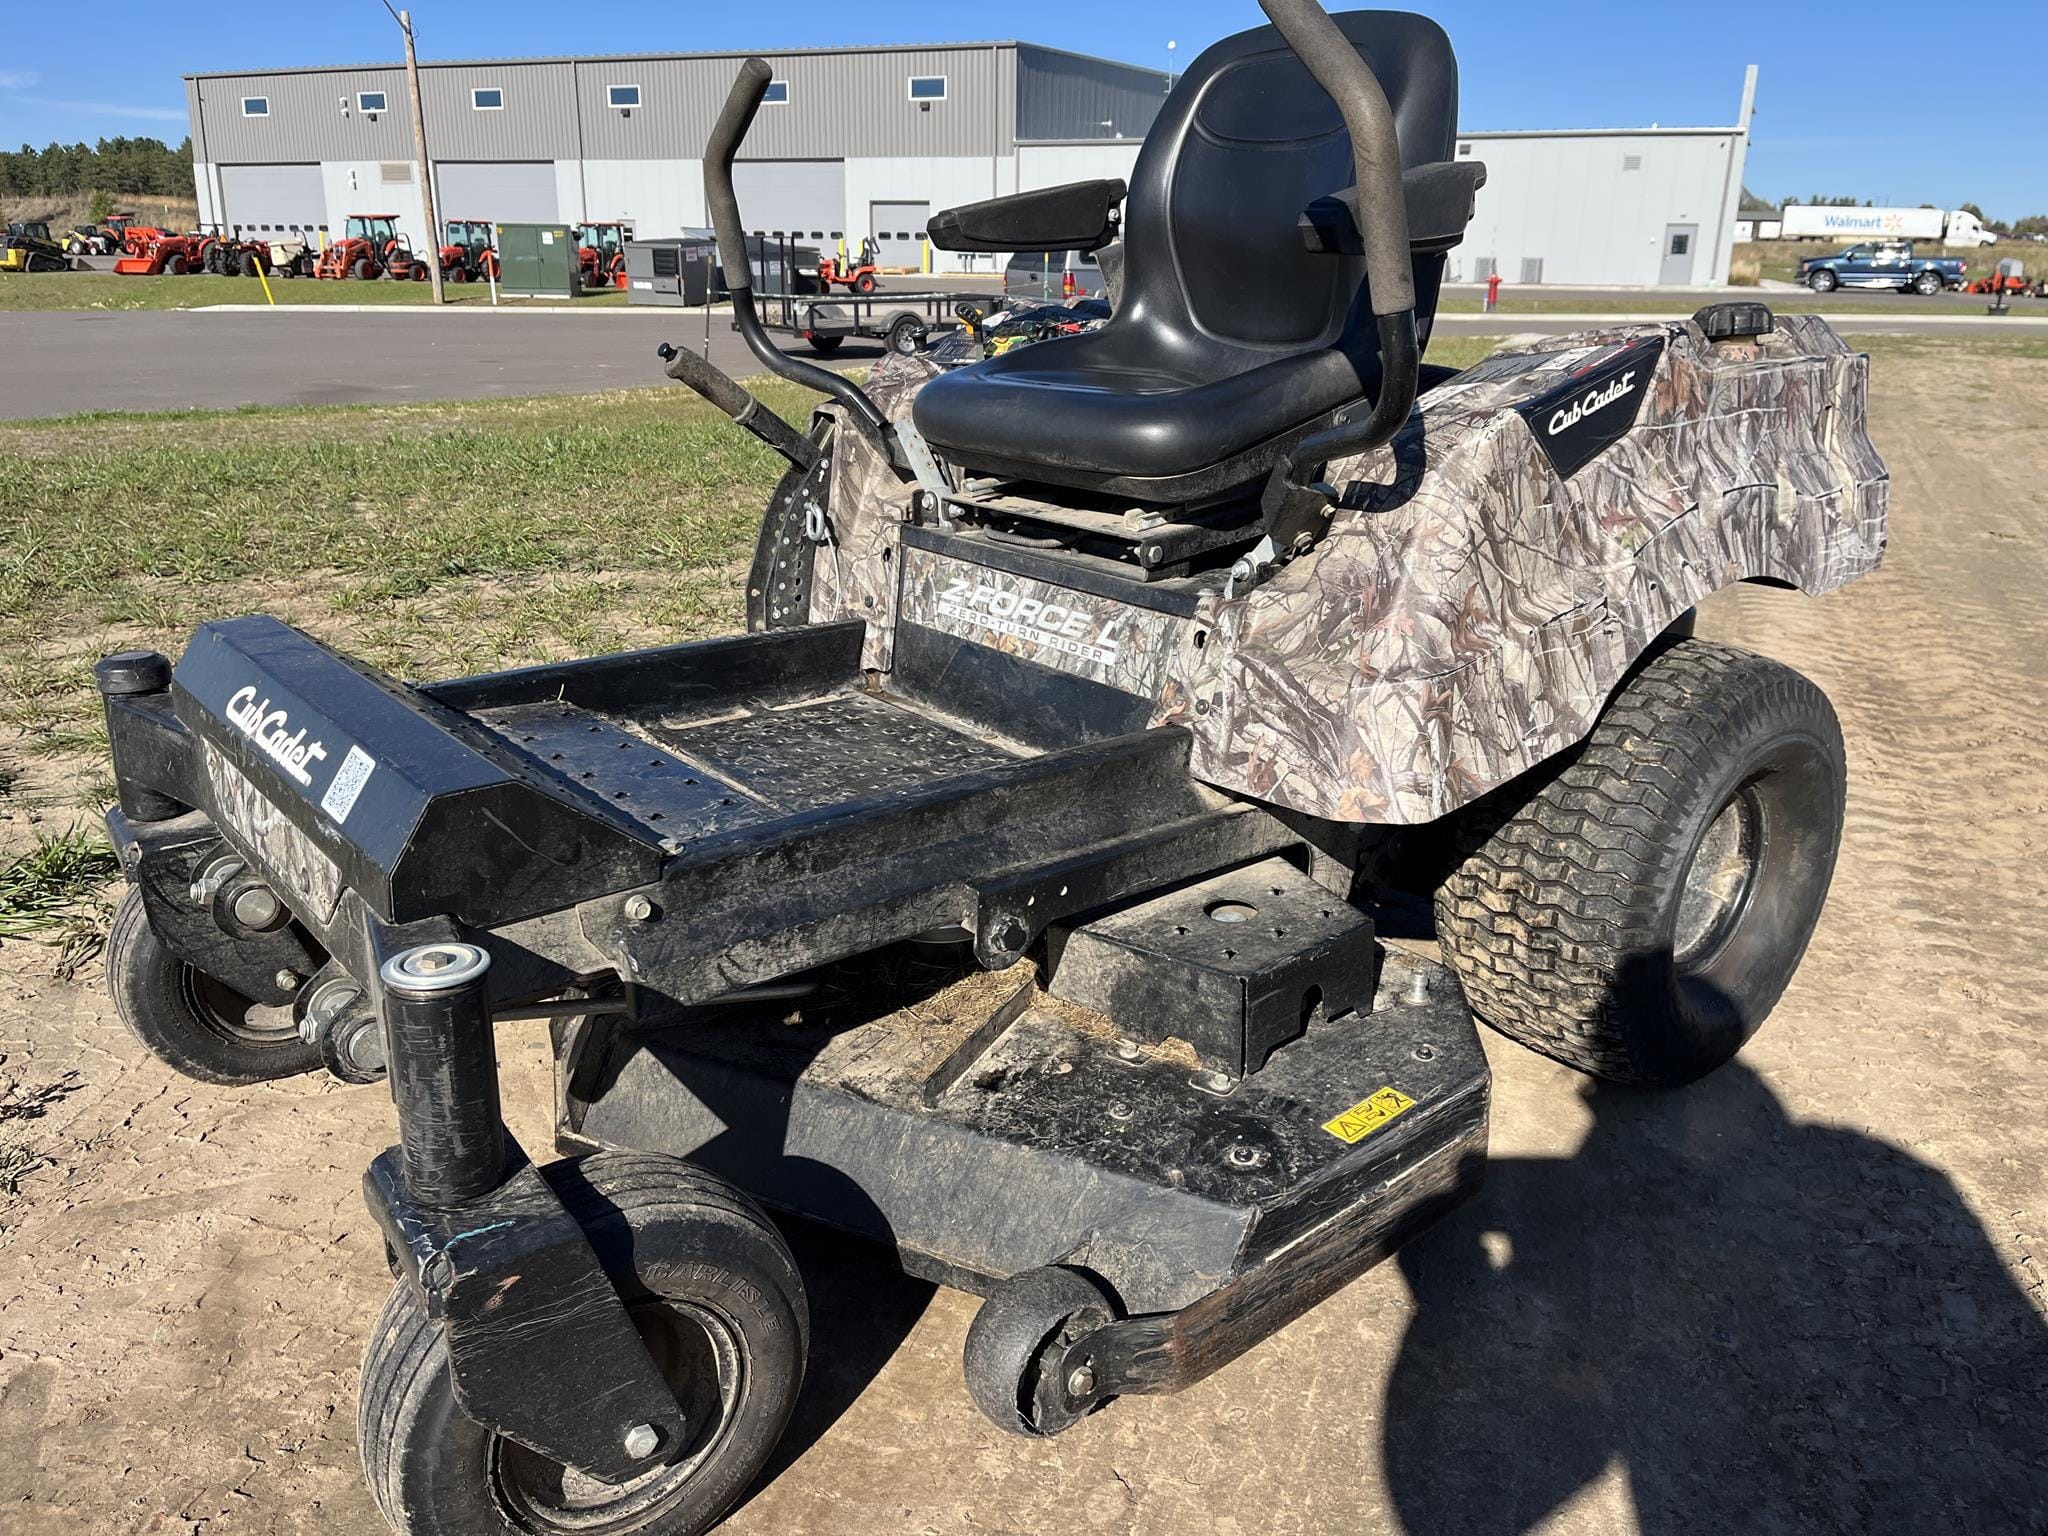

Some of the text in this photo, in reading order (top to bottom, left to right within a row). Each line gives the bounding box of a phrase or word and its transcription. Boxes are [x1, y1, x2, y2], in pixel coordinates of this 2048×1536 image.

[1825, 215, 1881, 228] Walmart
[949, 605, 1102, 661] ZERO-TURN RIDER
[1096, 620, 1119, 648] L
[645, 1262, 782, 1334] CARLISLE
